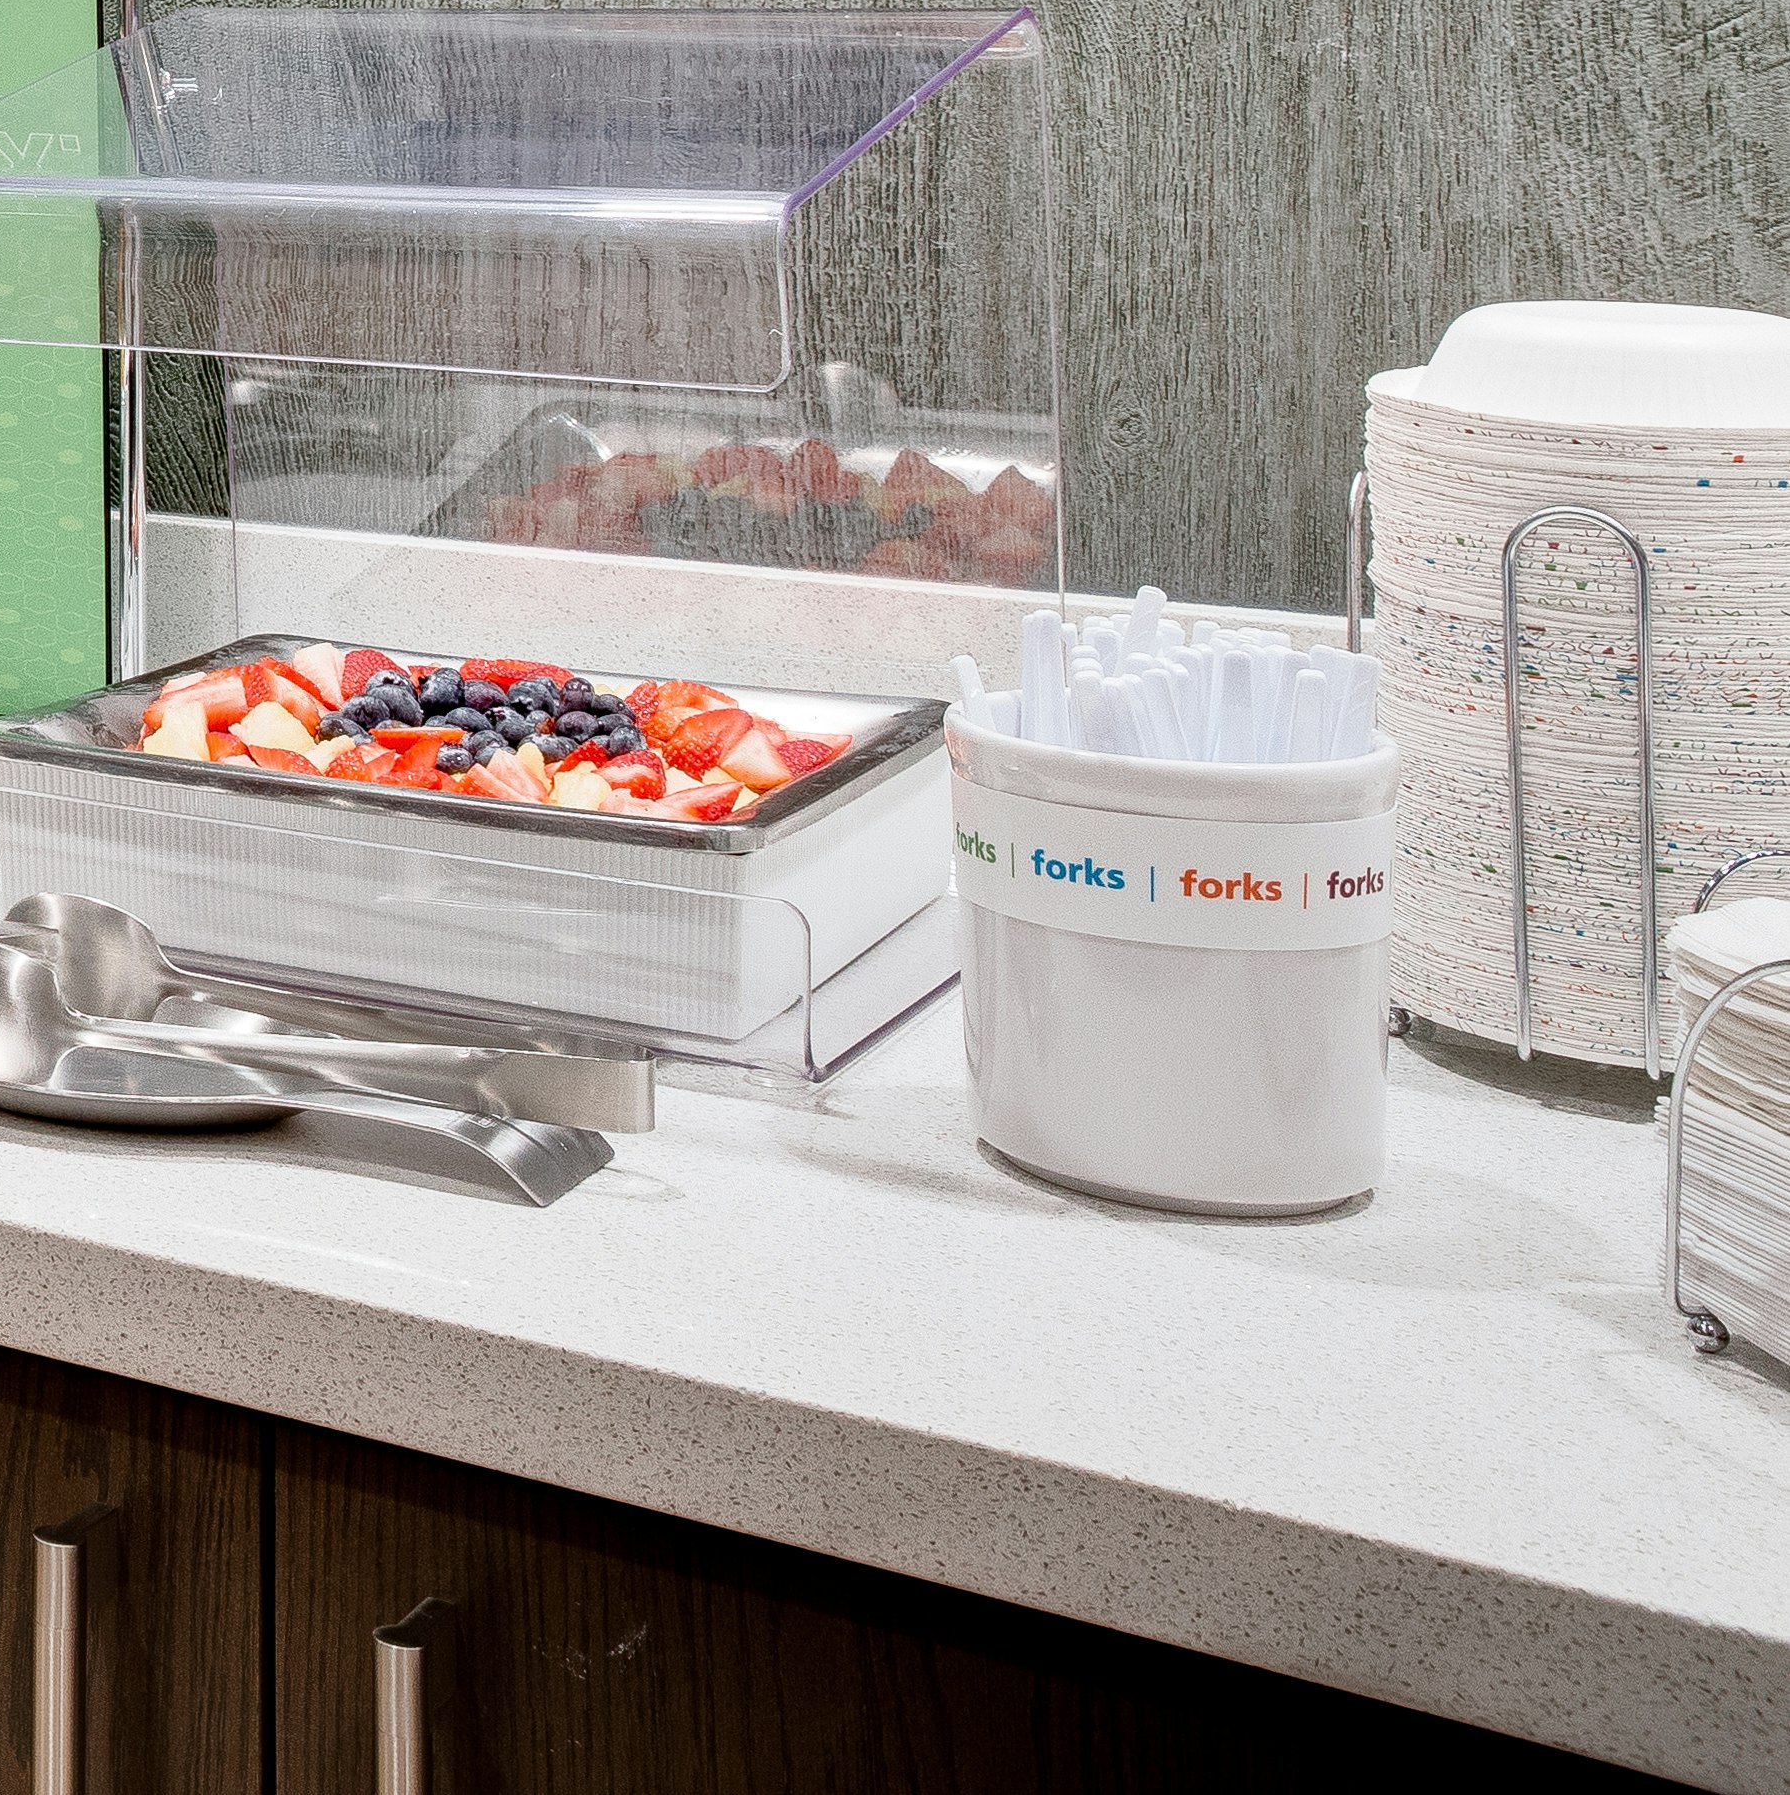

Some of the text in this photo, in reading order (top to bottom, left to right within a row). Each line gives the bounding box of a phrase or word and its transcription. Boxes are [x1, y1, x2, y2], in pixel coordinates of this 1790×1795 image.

[1030, 848, 1126, 890] forks
[1179, 868, 1283, 902] forks
[1325, 866, 1385, 901] forks
